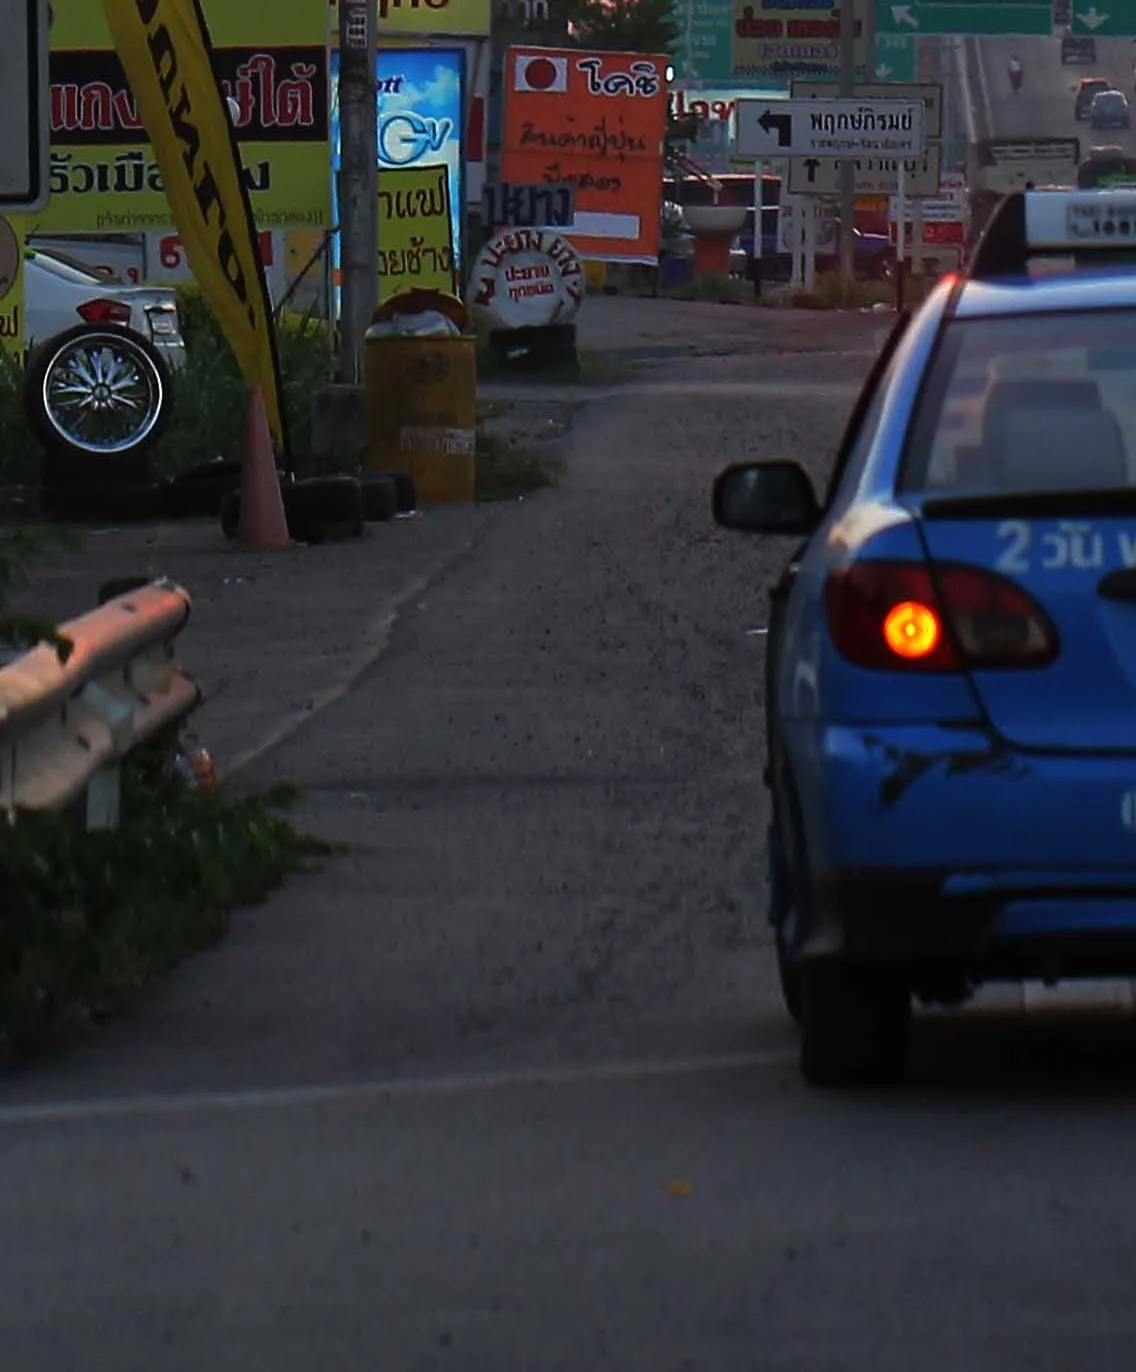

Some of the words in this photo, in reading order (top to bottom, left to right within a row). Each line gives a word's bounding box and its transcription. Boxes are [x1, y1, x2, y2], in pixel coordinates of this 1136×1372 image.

[810, 107, 912, 135] พฤกษ์ภิรมย์
[995, 519, 1031, 575] 2
[1041, 522, 1105, 569] วัน
